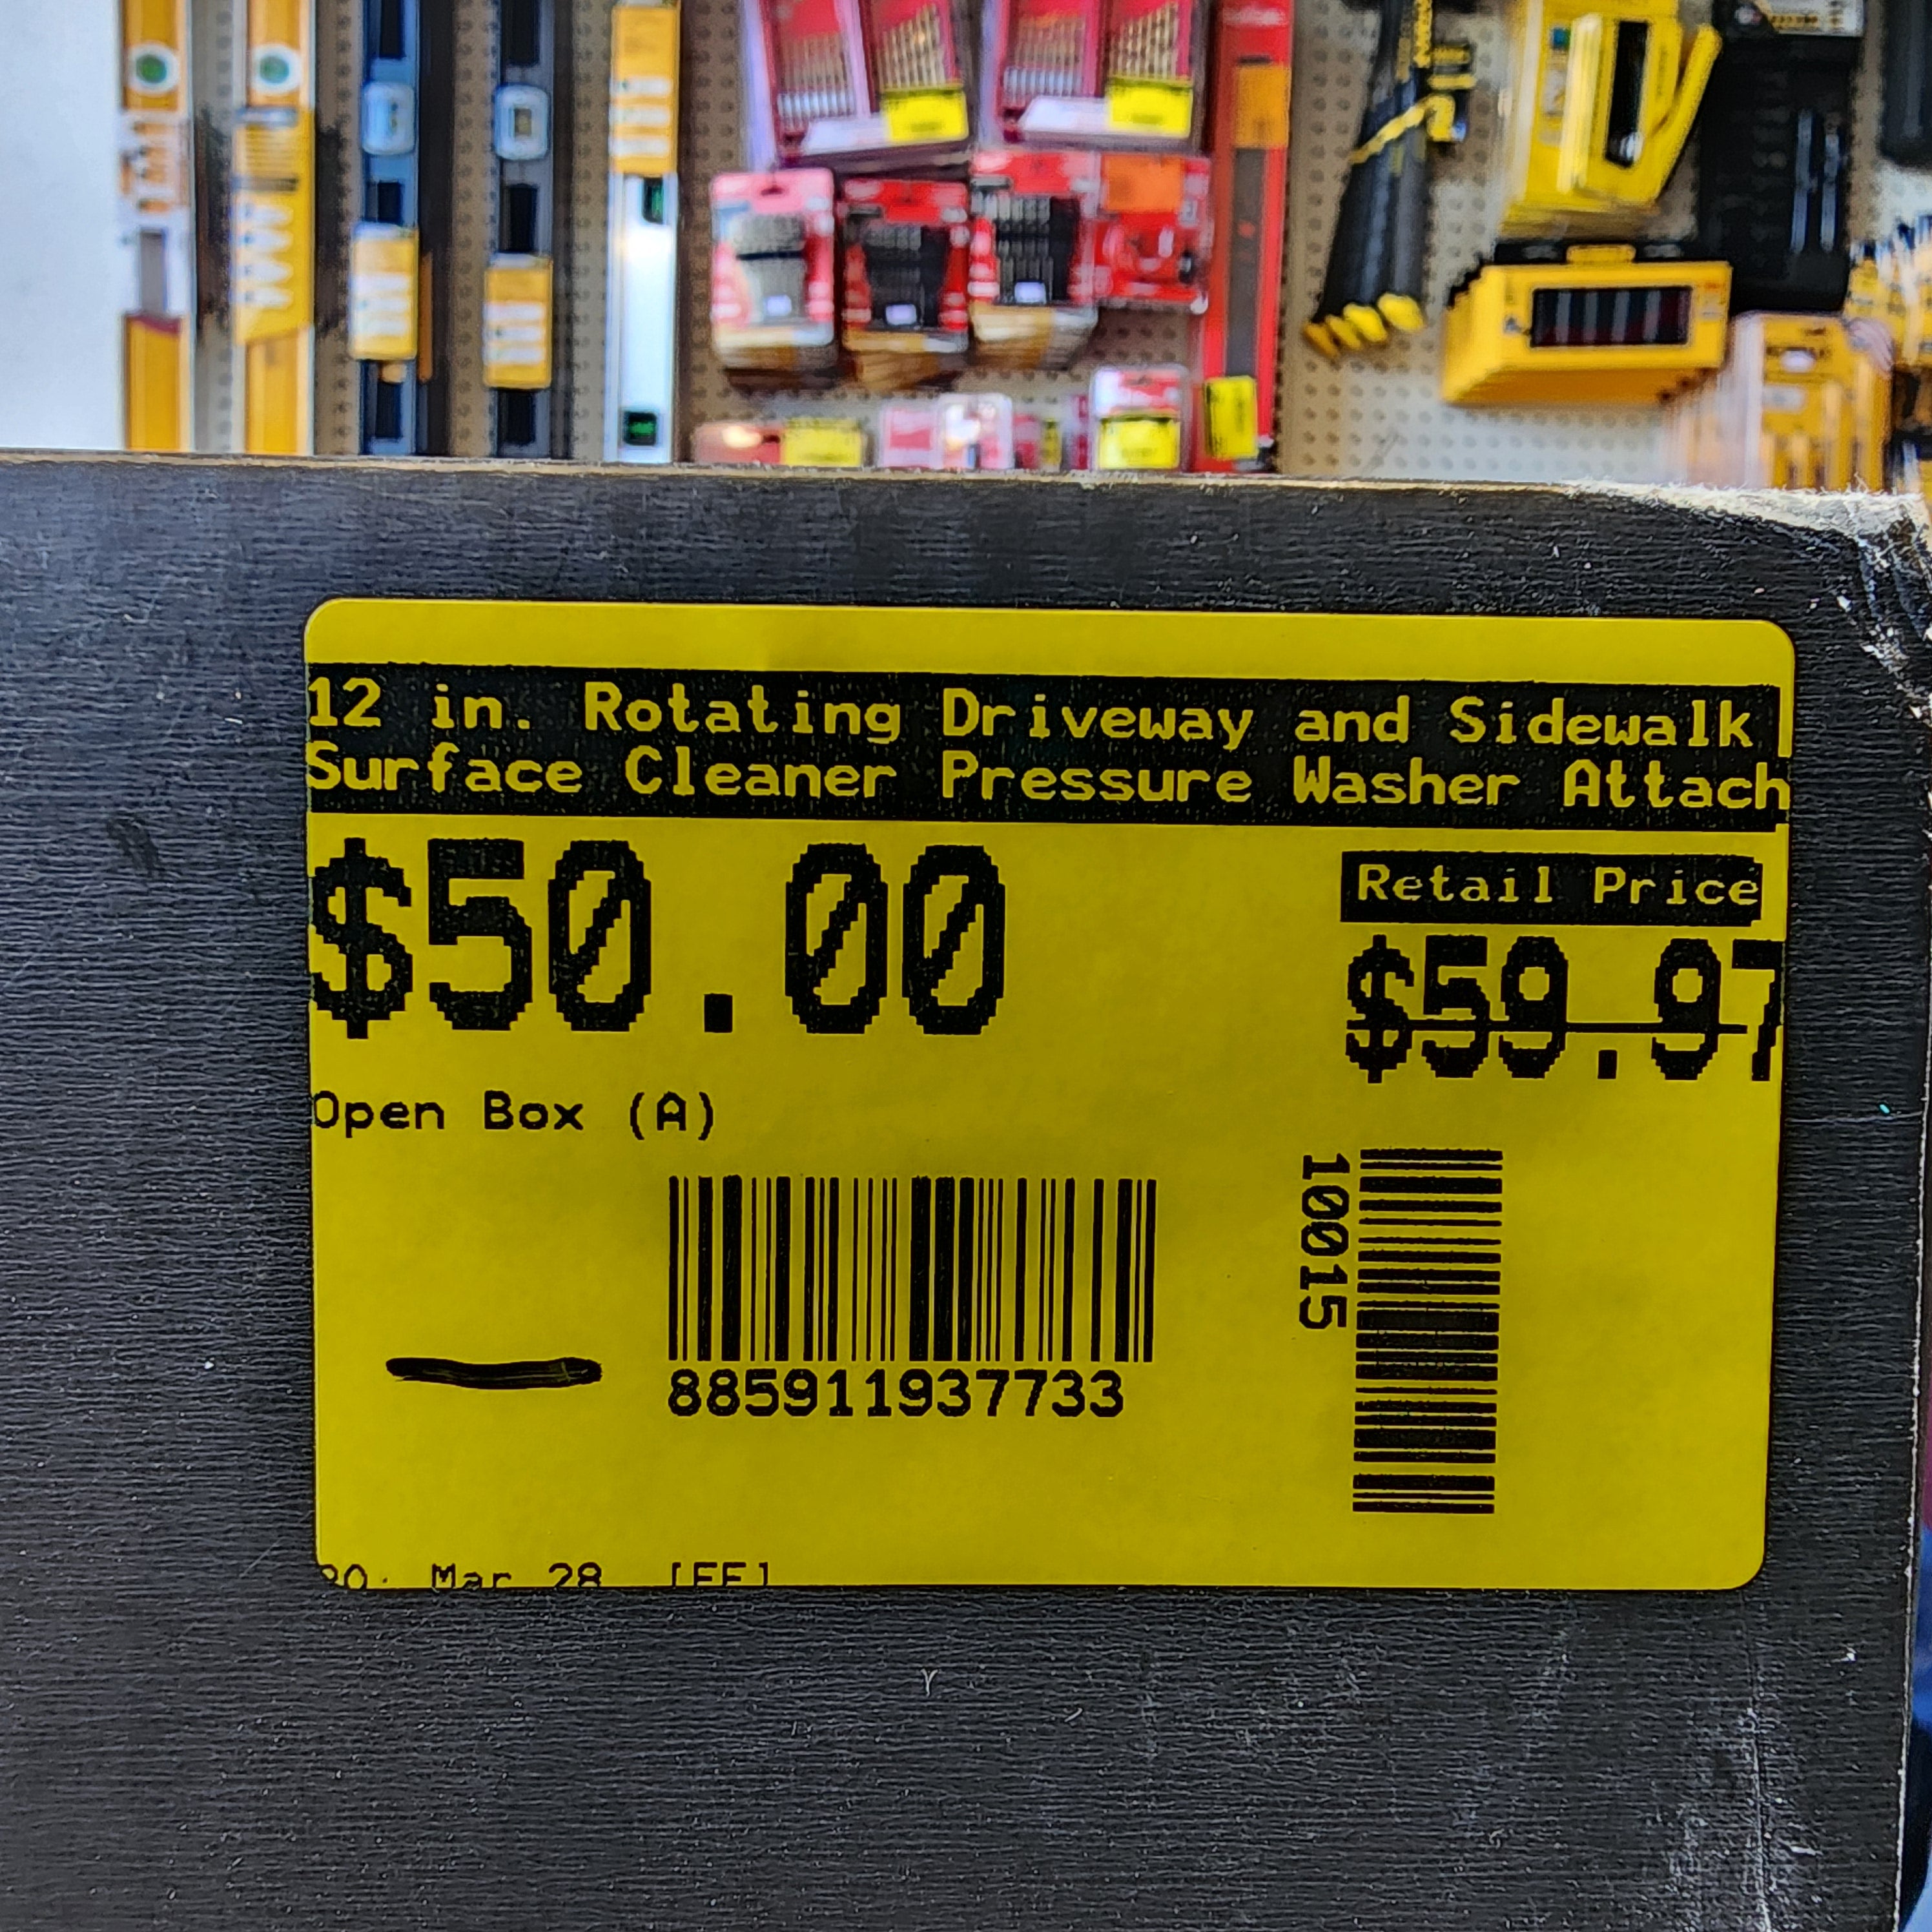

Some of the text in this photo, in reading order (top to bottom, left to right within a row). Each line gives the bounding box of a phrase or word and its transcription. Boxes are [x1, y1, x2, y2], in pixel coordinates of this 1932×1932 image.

[308, 677, 1754, 752] 12 in. Rotating Driveway and Sidewalk
[305, 740, 1791, 810] Surface Cleaner Pressure Washer Attach
[1357, 863, 1760, 907] Retail Price
[311, 837, 1005, 1040] $50.00
[1345, 934, 1786, 1084] $59.97
[312, 1090, 714, 1142] Open Box (A)
[1299, 1153, 1351, 1330] 10015
[668, 1368, 1124, 1417] 885911937733
[431, 1563, 512, 1589] Mar
